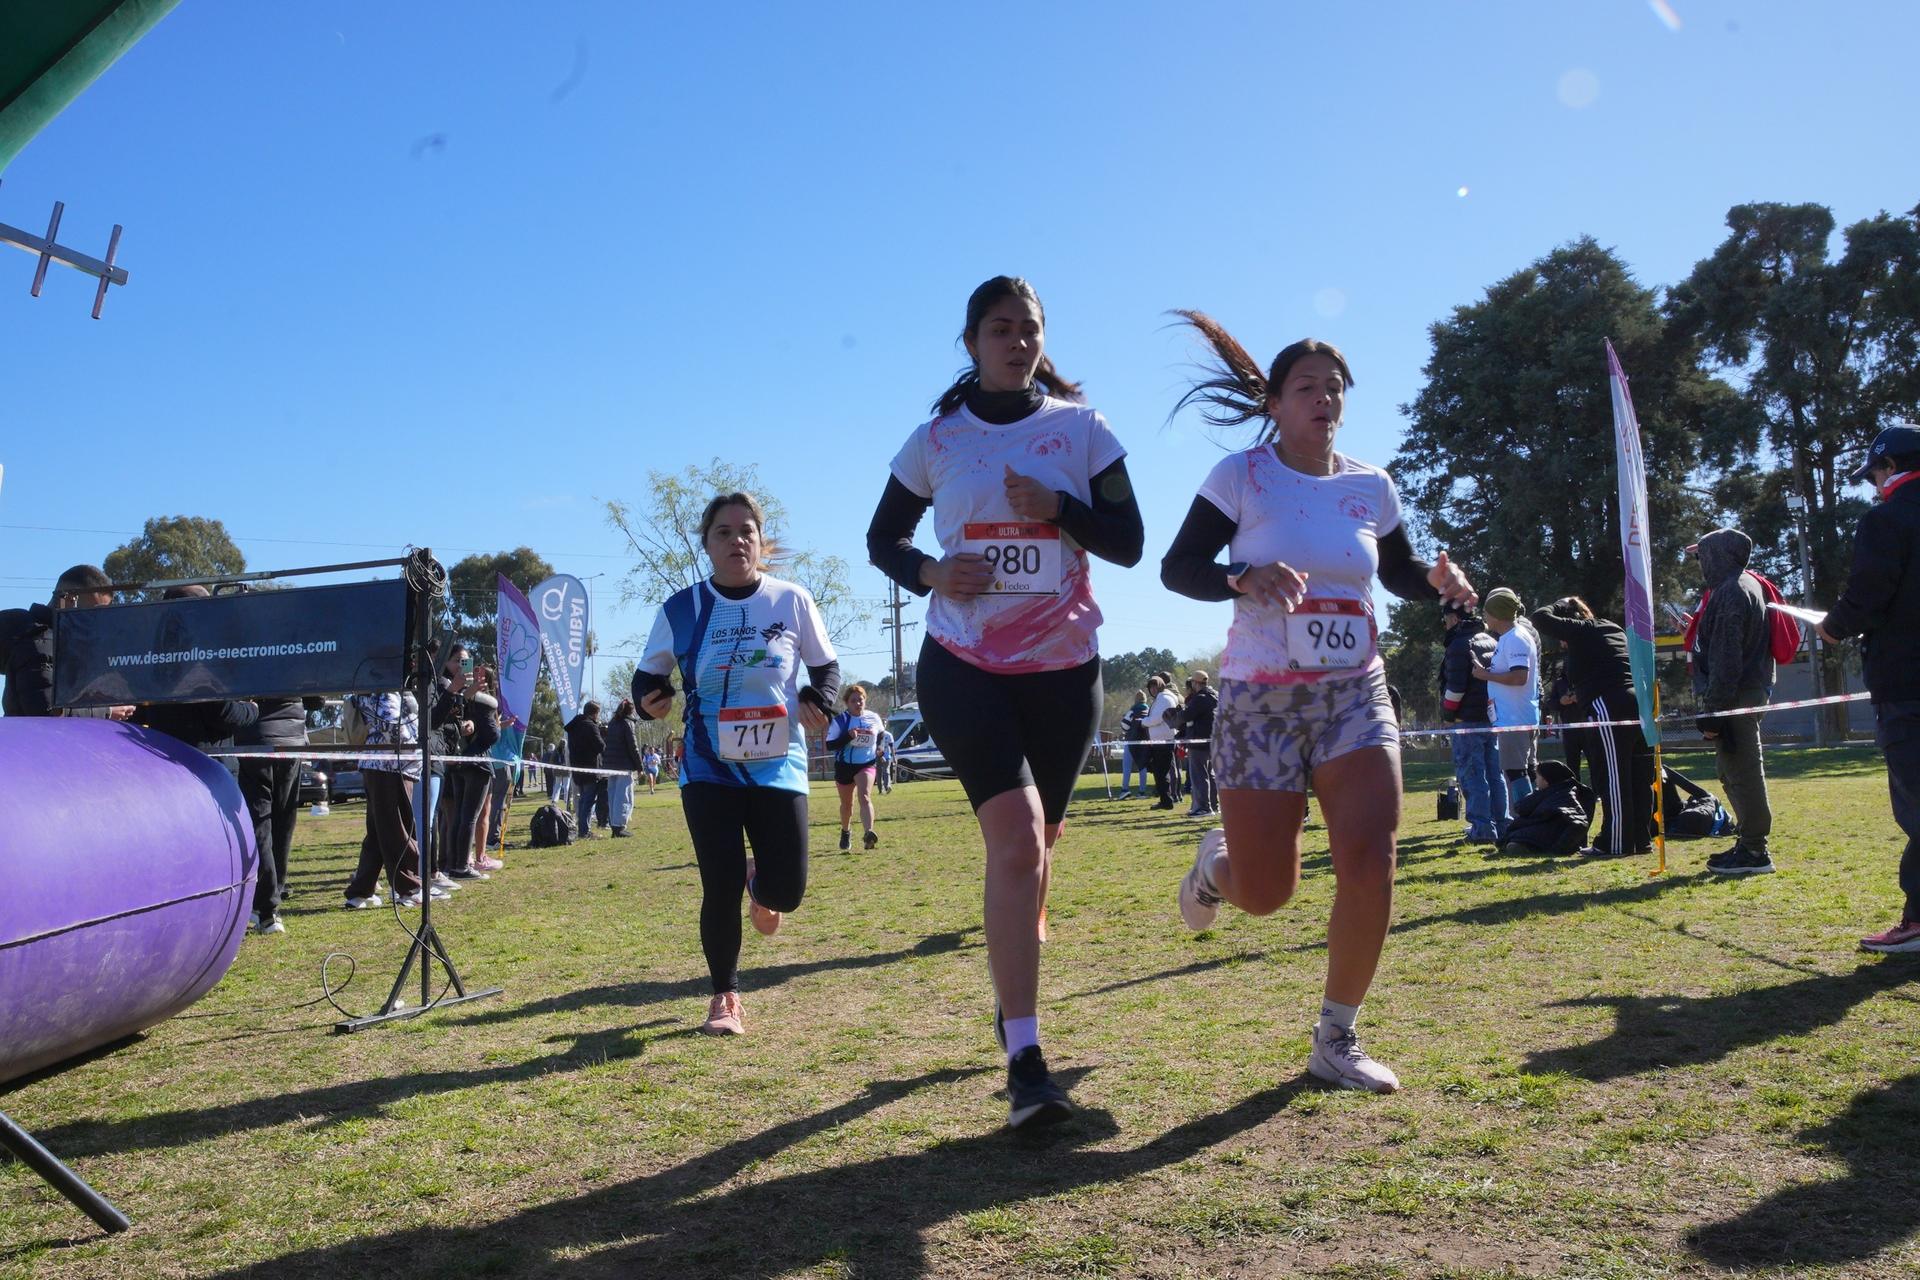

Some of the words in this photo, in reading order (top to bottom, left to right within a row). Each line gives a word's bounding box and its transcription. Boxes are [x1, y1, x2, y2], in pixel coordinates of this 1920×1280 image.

[998, 527, 1020, 537] ULTRA
[984, 545, 1040, 575] 980
[711, 629, 727, 639] LOS
[730, 626, 757, 636] TANOS
[1308, 620, 1356, 650] 966
[734, 722, 775, 747] 717
[856, 735, 870, 743] 750
